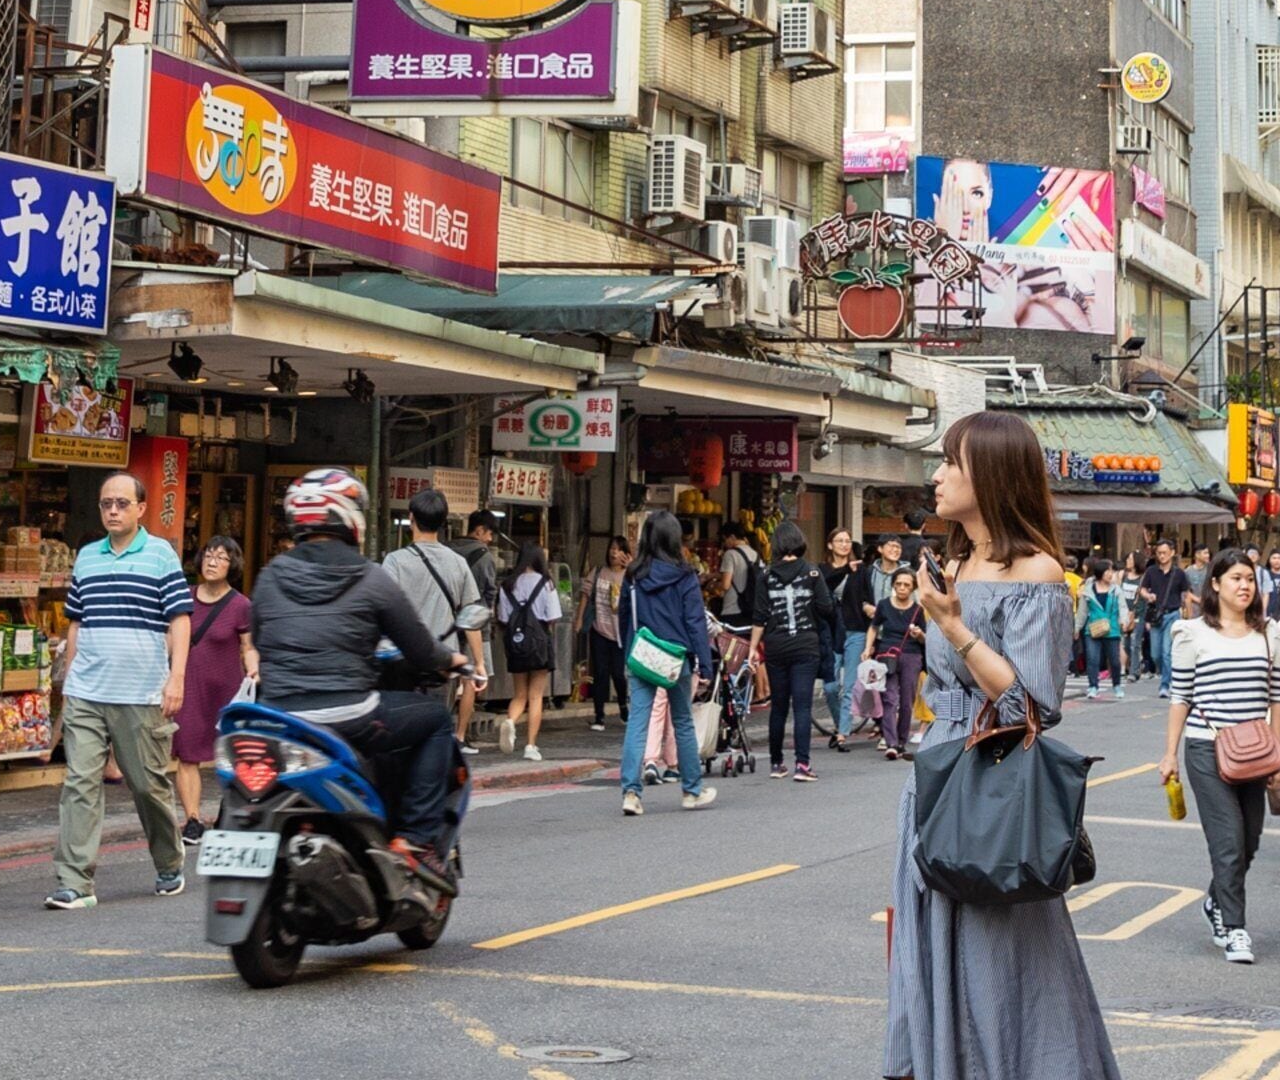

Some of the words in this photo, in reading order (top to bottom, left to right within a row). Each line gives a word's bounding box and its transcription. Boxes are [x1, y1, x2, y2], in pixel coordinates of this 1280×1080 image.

[30, 287, 98, 320] 各式小菜
[729, 457, 754, 468] Fruit
[757, 458, 791, 469] Garden
